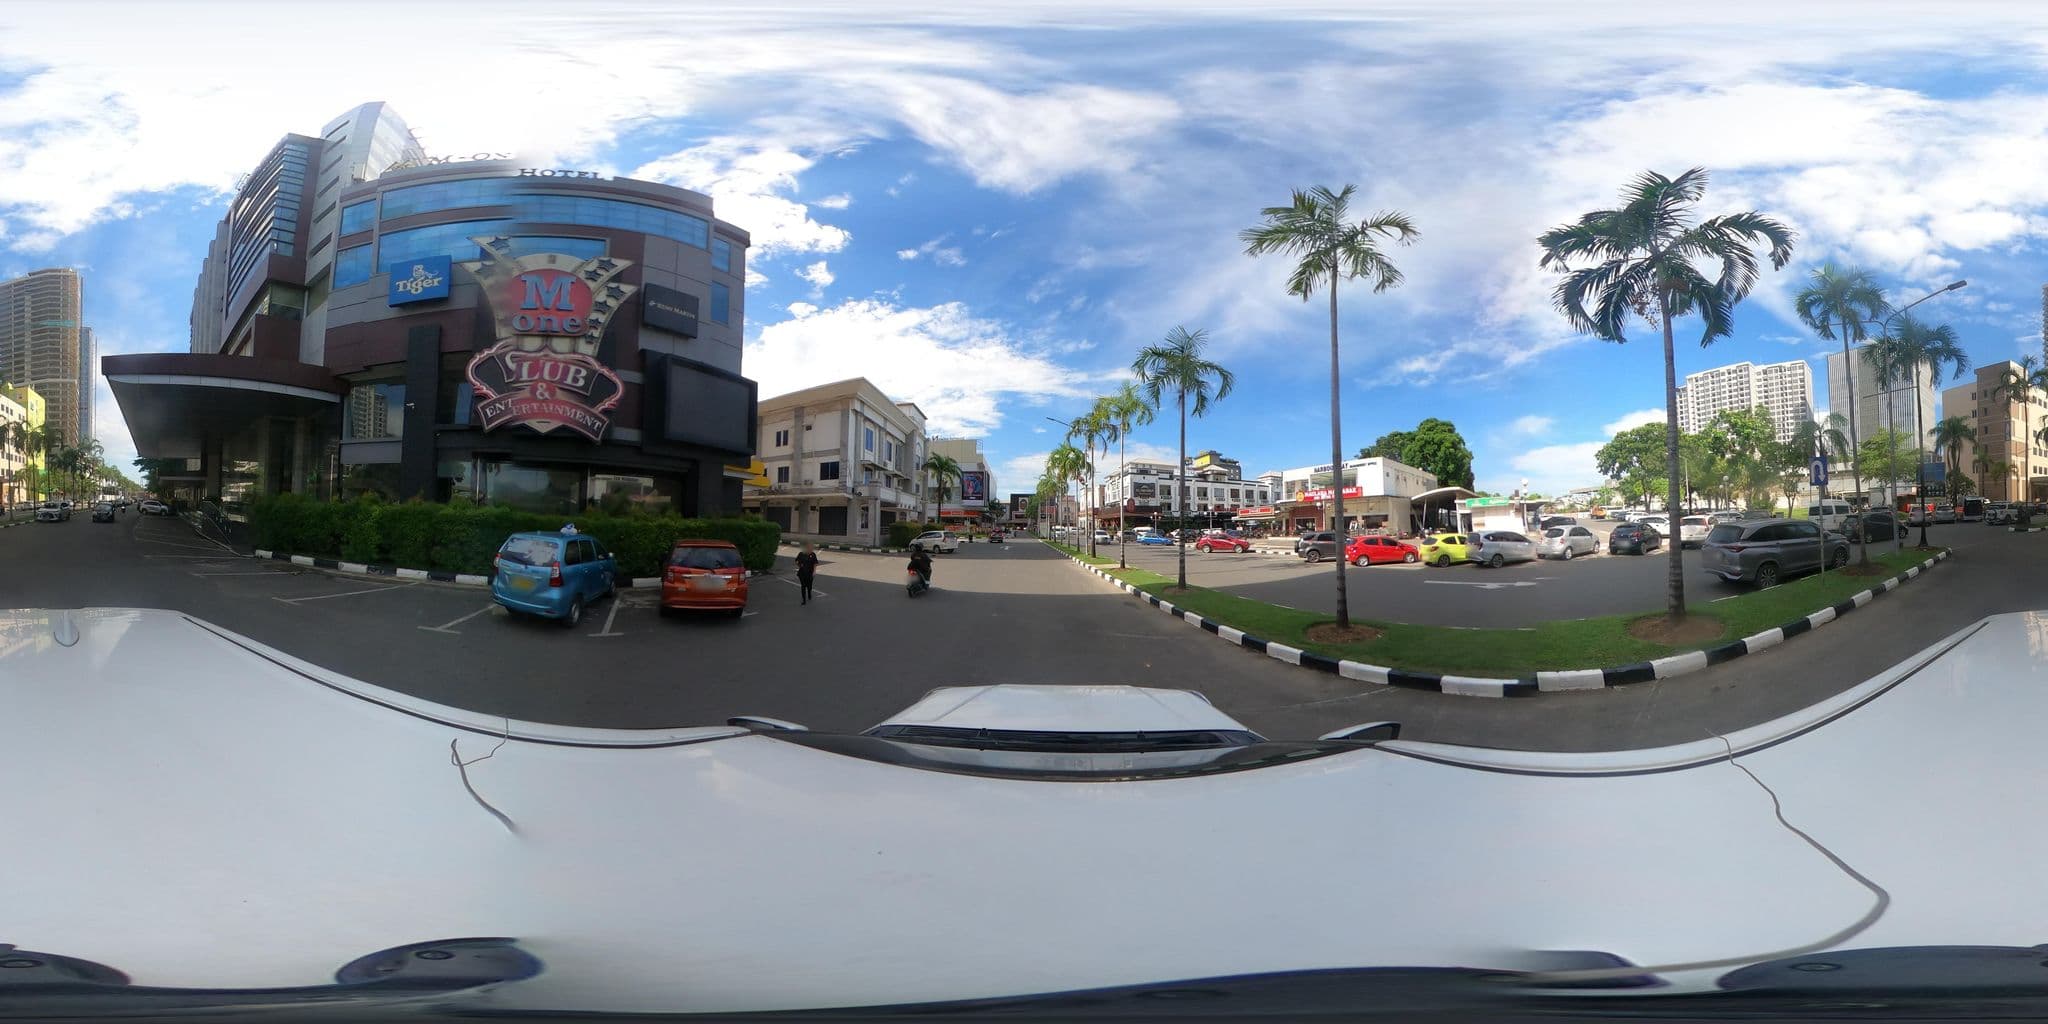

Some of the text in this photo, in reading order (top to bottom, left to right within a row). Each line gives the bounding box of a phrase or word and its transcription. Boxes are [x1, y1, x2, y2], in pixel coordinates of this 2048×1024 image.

[518, 168, 603, 179] HOTEL
[396, 277, 443, 295] Tiger
[520, 274, 577, 311] M
[512, 314, 582, 333] one
[536, 382, 551, 400] &
